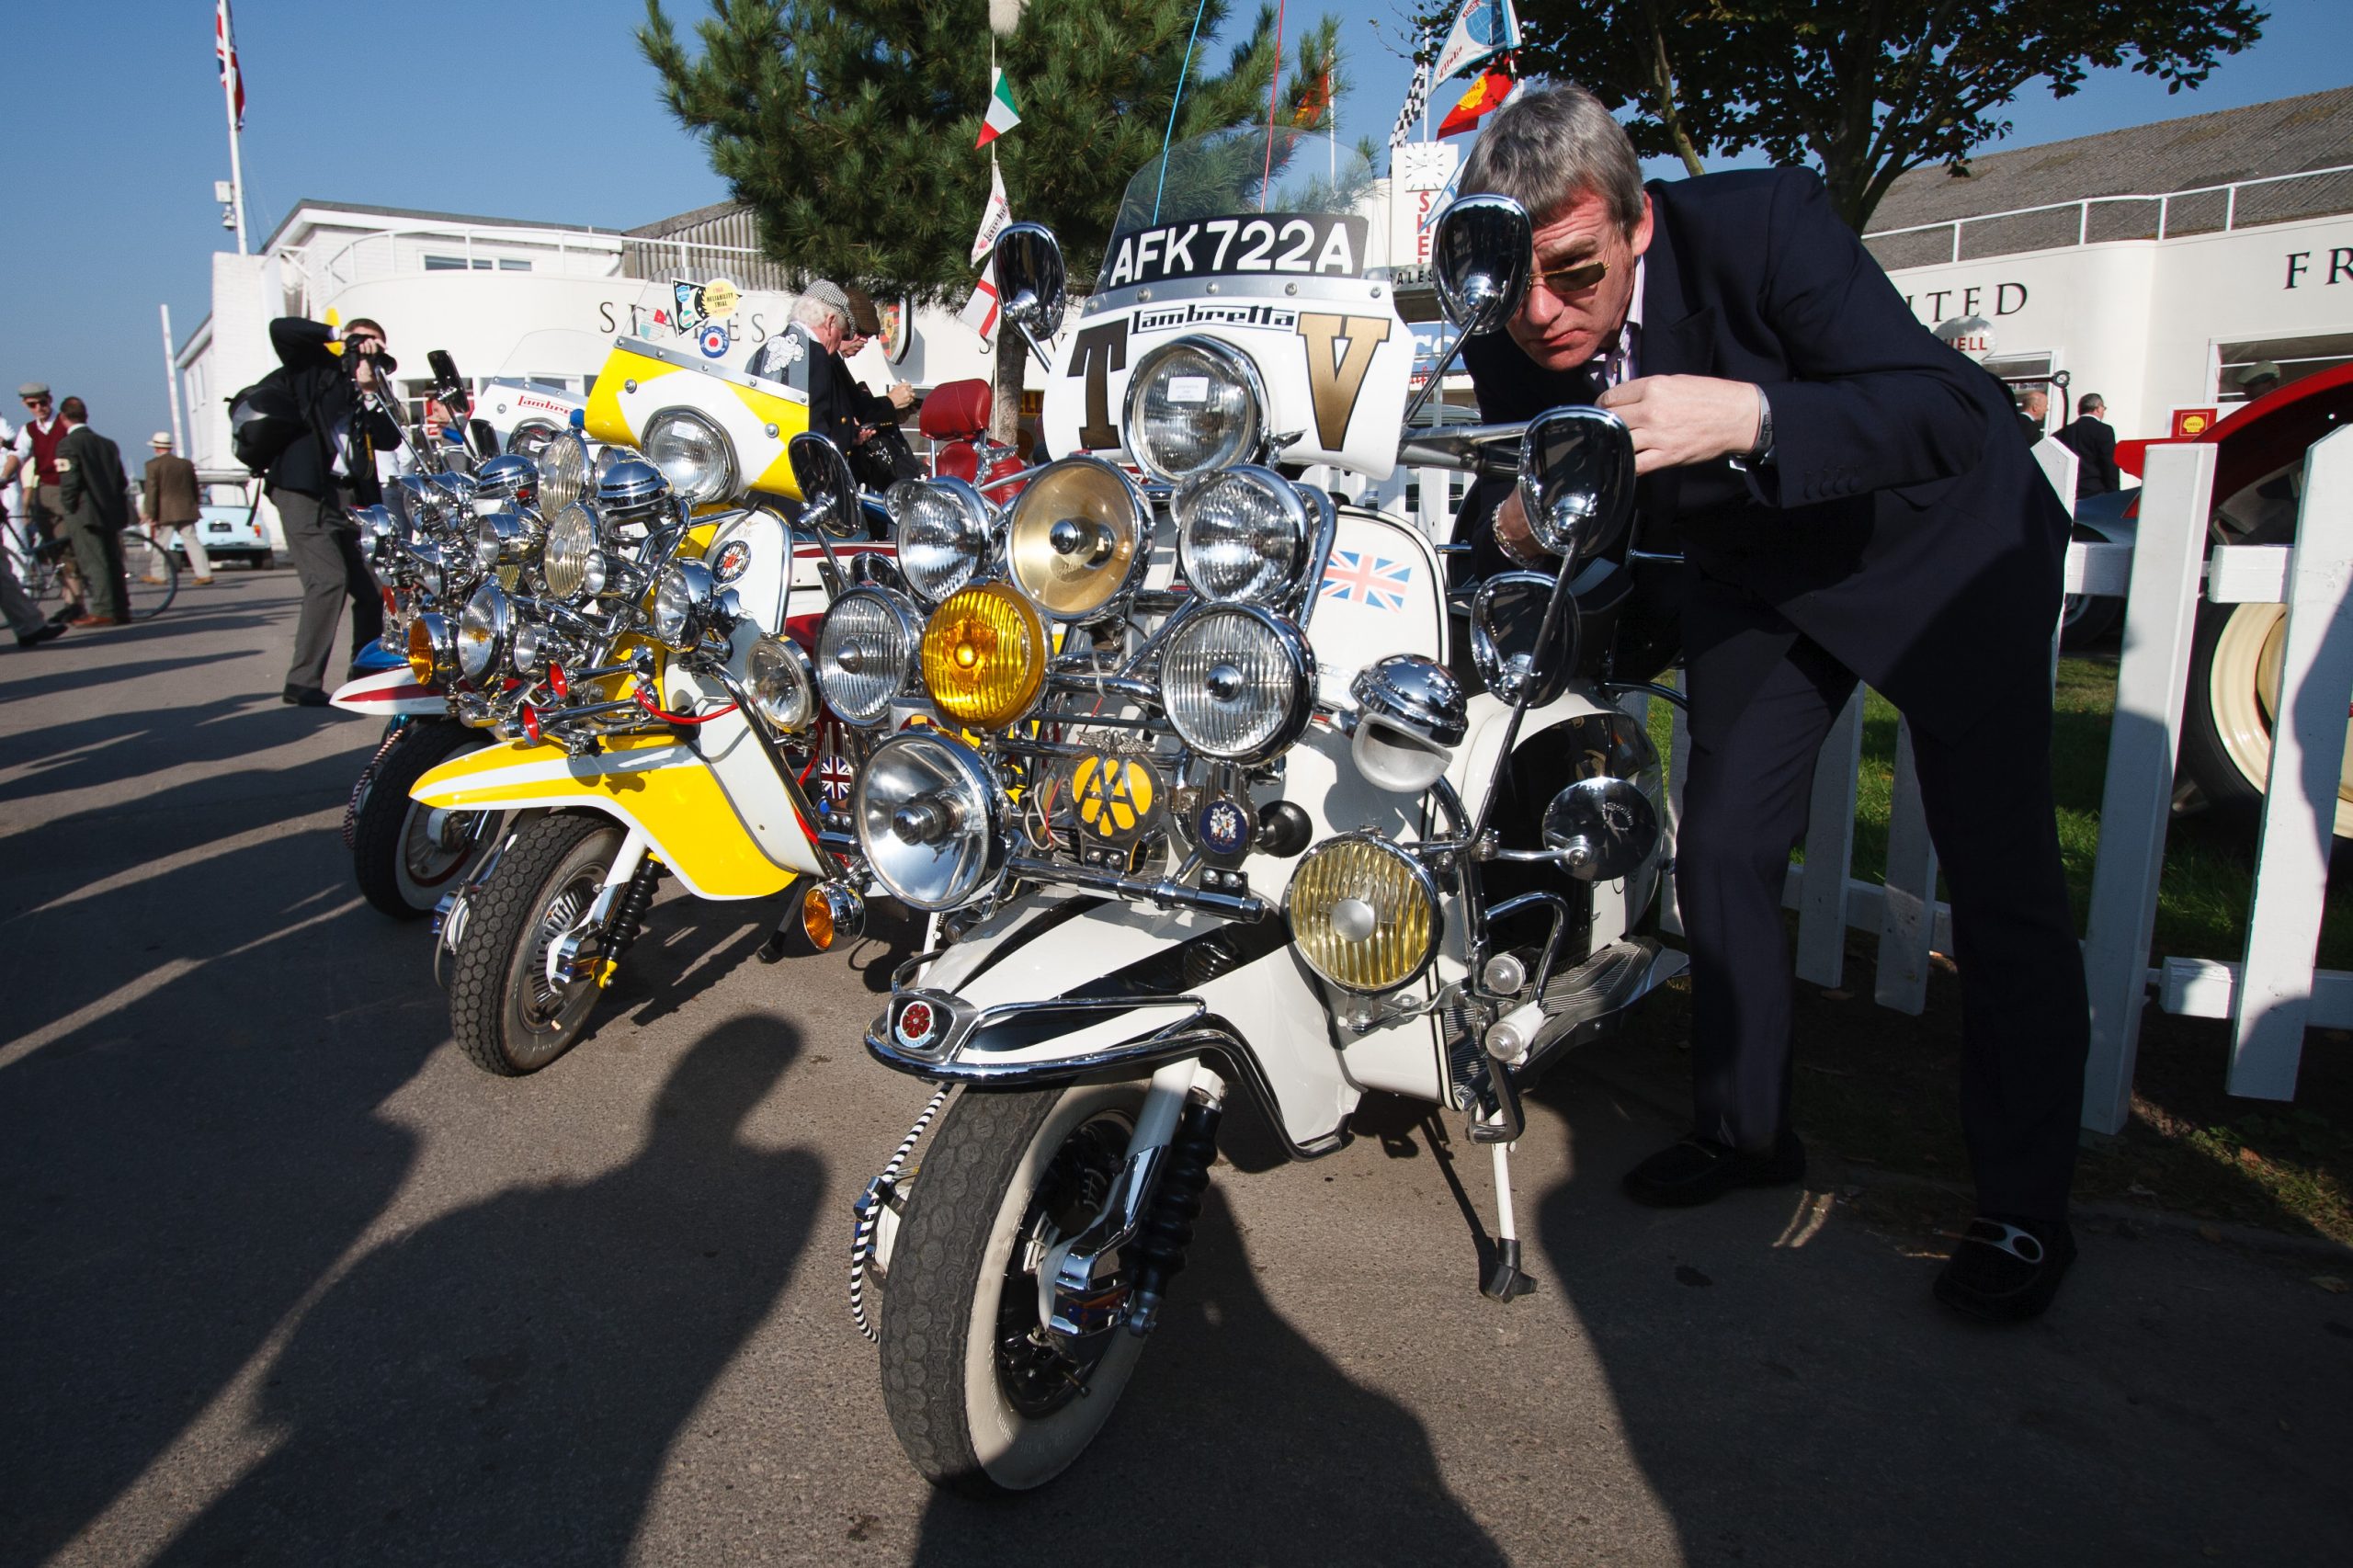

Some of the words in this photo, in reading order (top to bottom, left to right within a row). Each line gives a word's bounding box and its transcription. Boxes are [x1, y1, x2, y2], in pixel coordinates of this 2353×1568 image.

[1416, 191, 1430, 264] SHE
[1109, 224, 1199, 287] AFK
[1206, 220, 1354, 275] 722A
[2283, 247, 2353, 290] FR
[1389, 269, 1433, 285] ALES
[1131, 304, 1295, 335] Lambretta
[1944, 336, 1988, 351] HELL
[1067, 317, 1130, 451] T
[1297, 312, 1392, 452] V
[517, 395, 572, 415] Lambre
